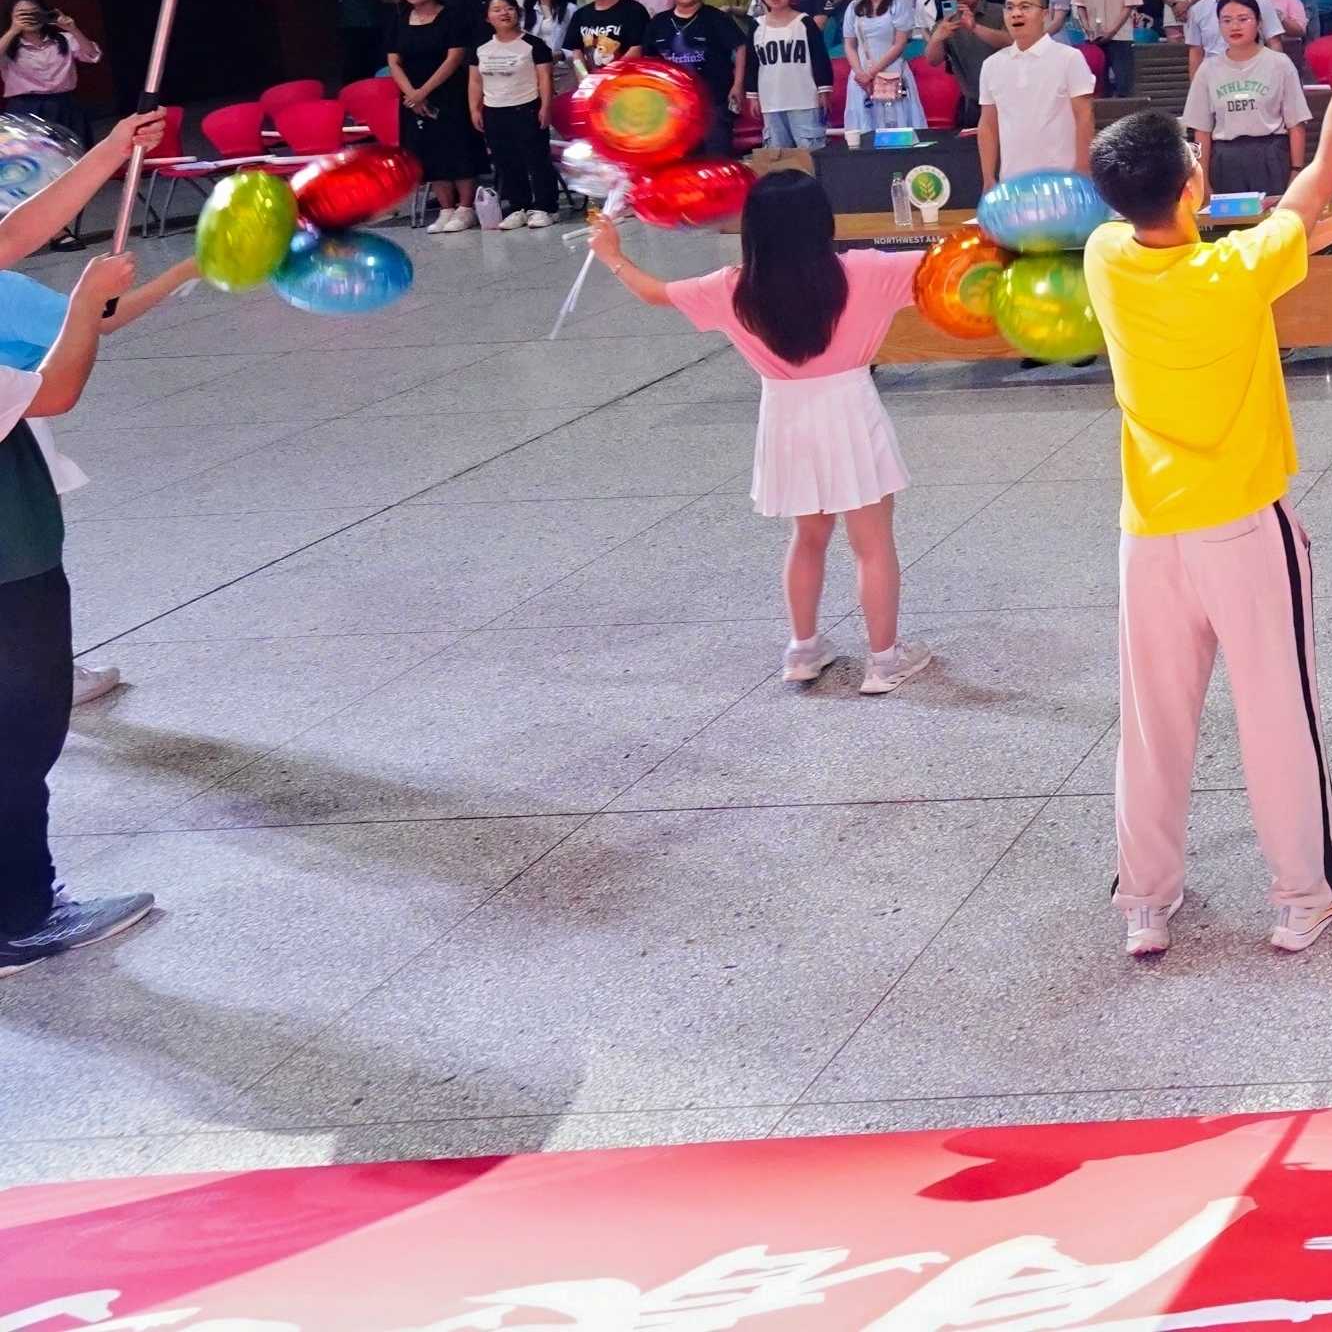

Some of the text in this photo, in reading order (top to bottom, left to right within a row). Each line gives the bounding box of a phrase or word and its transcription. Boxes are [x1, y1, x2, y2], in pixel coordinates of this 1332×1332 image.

[580, 25, 622, 37] KUNGFU
[1215, 79, 1271, 99] ATHLETIC
[1227, 98, 1258, 113] DEPT.
